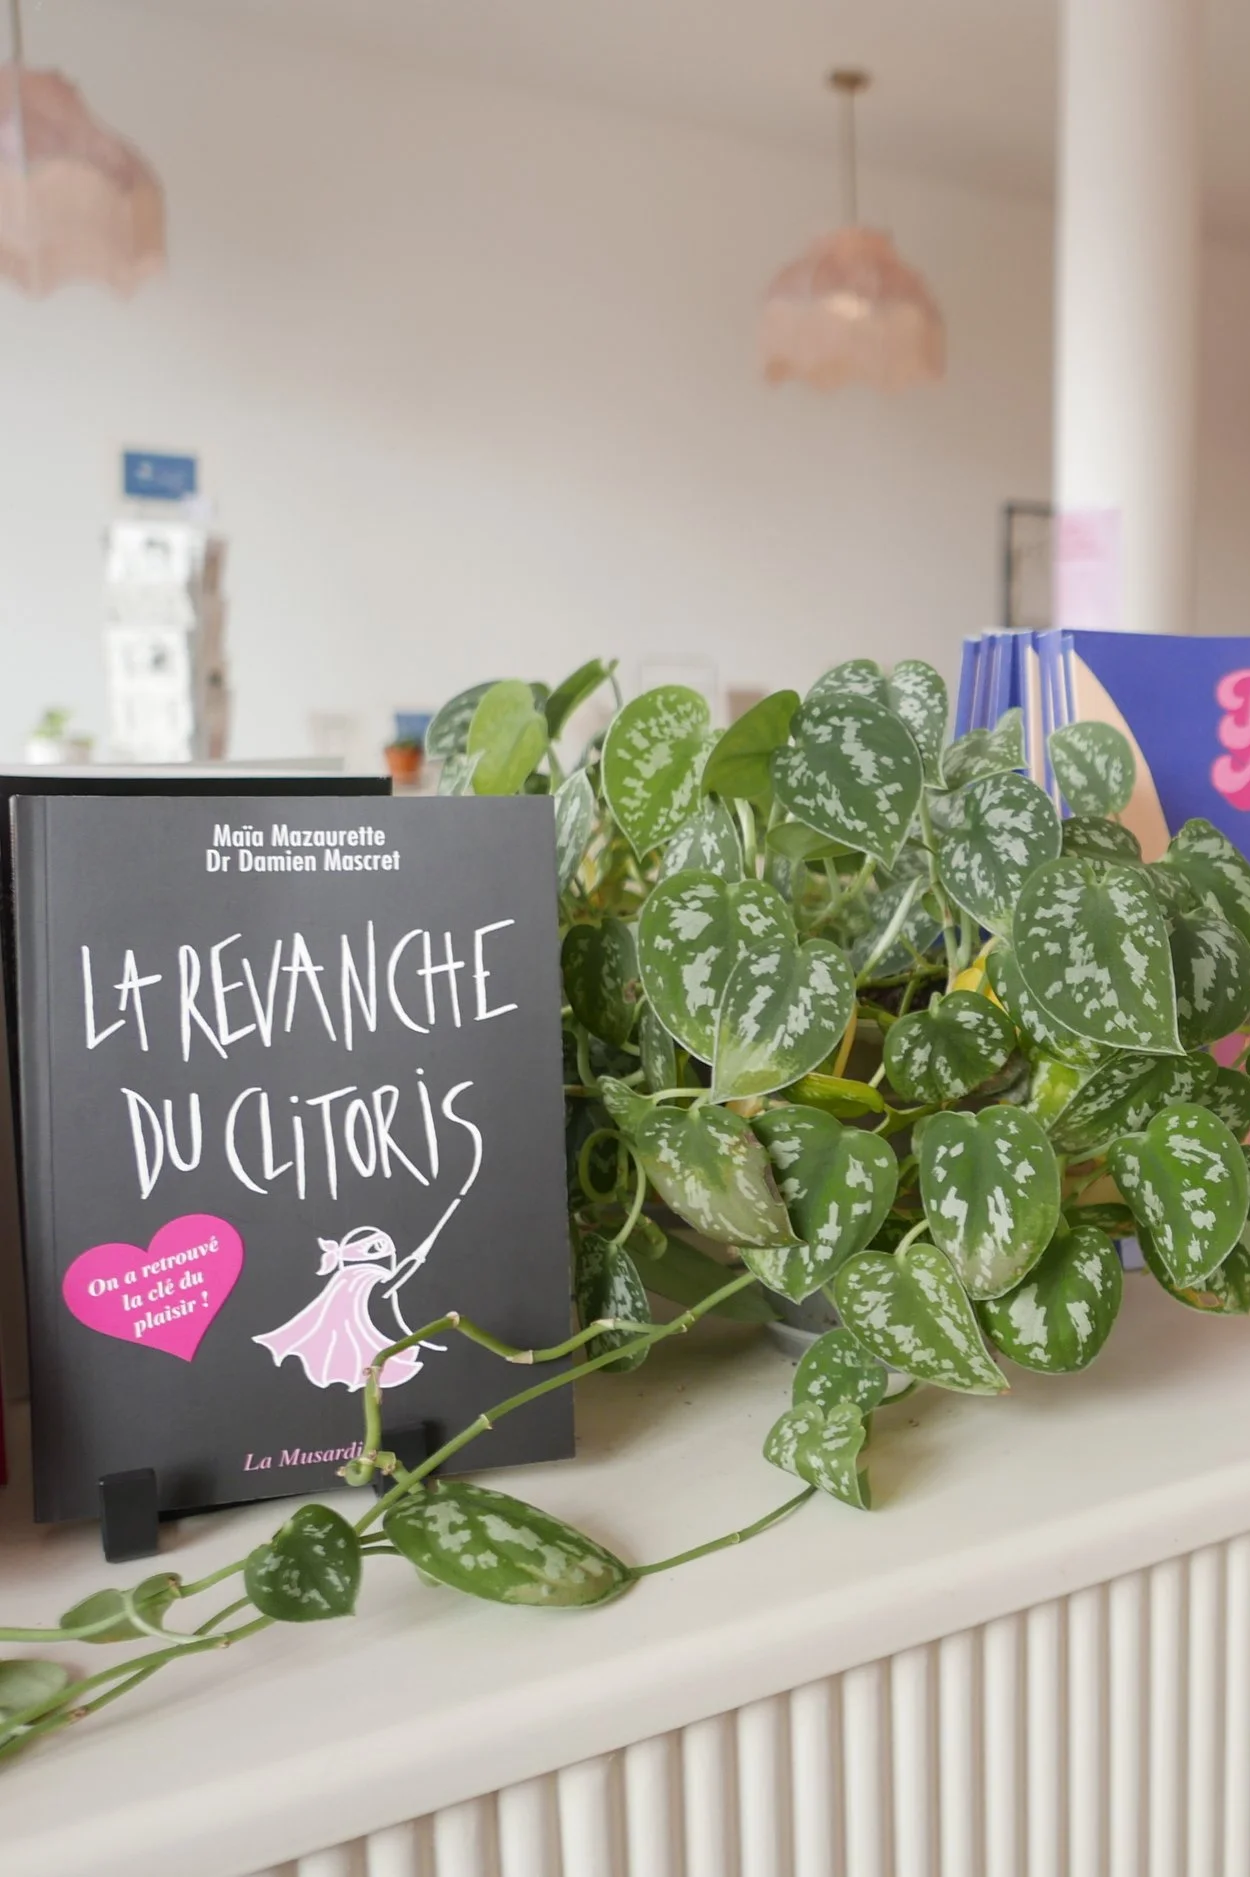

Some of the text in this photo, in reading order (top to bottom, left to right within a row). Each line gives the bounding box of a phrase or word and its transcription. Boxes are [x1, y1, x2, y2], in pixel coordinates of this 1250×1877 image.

[213, 823, 387, 848] Maïa Mazaurette
[205, 848, 401, 873] Dr Damien Mascret
[81, 919, 519, 1063] LA REVANCHE
[120, 1086, 202, 1200] DU
[87, 1235, 220, 1297] On a retrouvé
[121, 1270, 205, 1311] la clé du
[133, 1299, 197, 1339] plaisir
[243, 1440, 364, 1472] La Musardi
